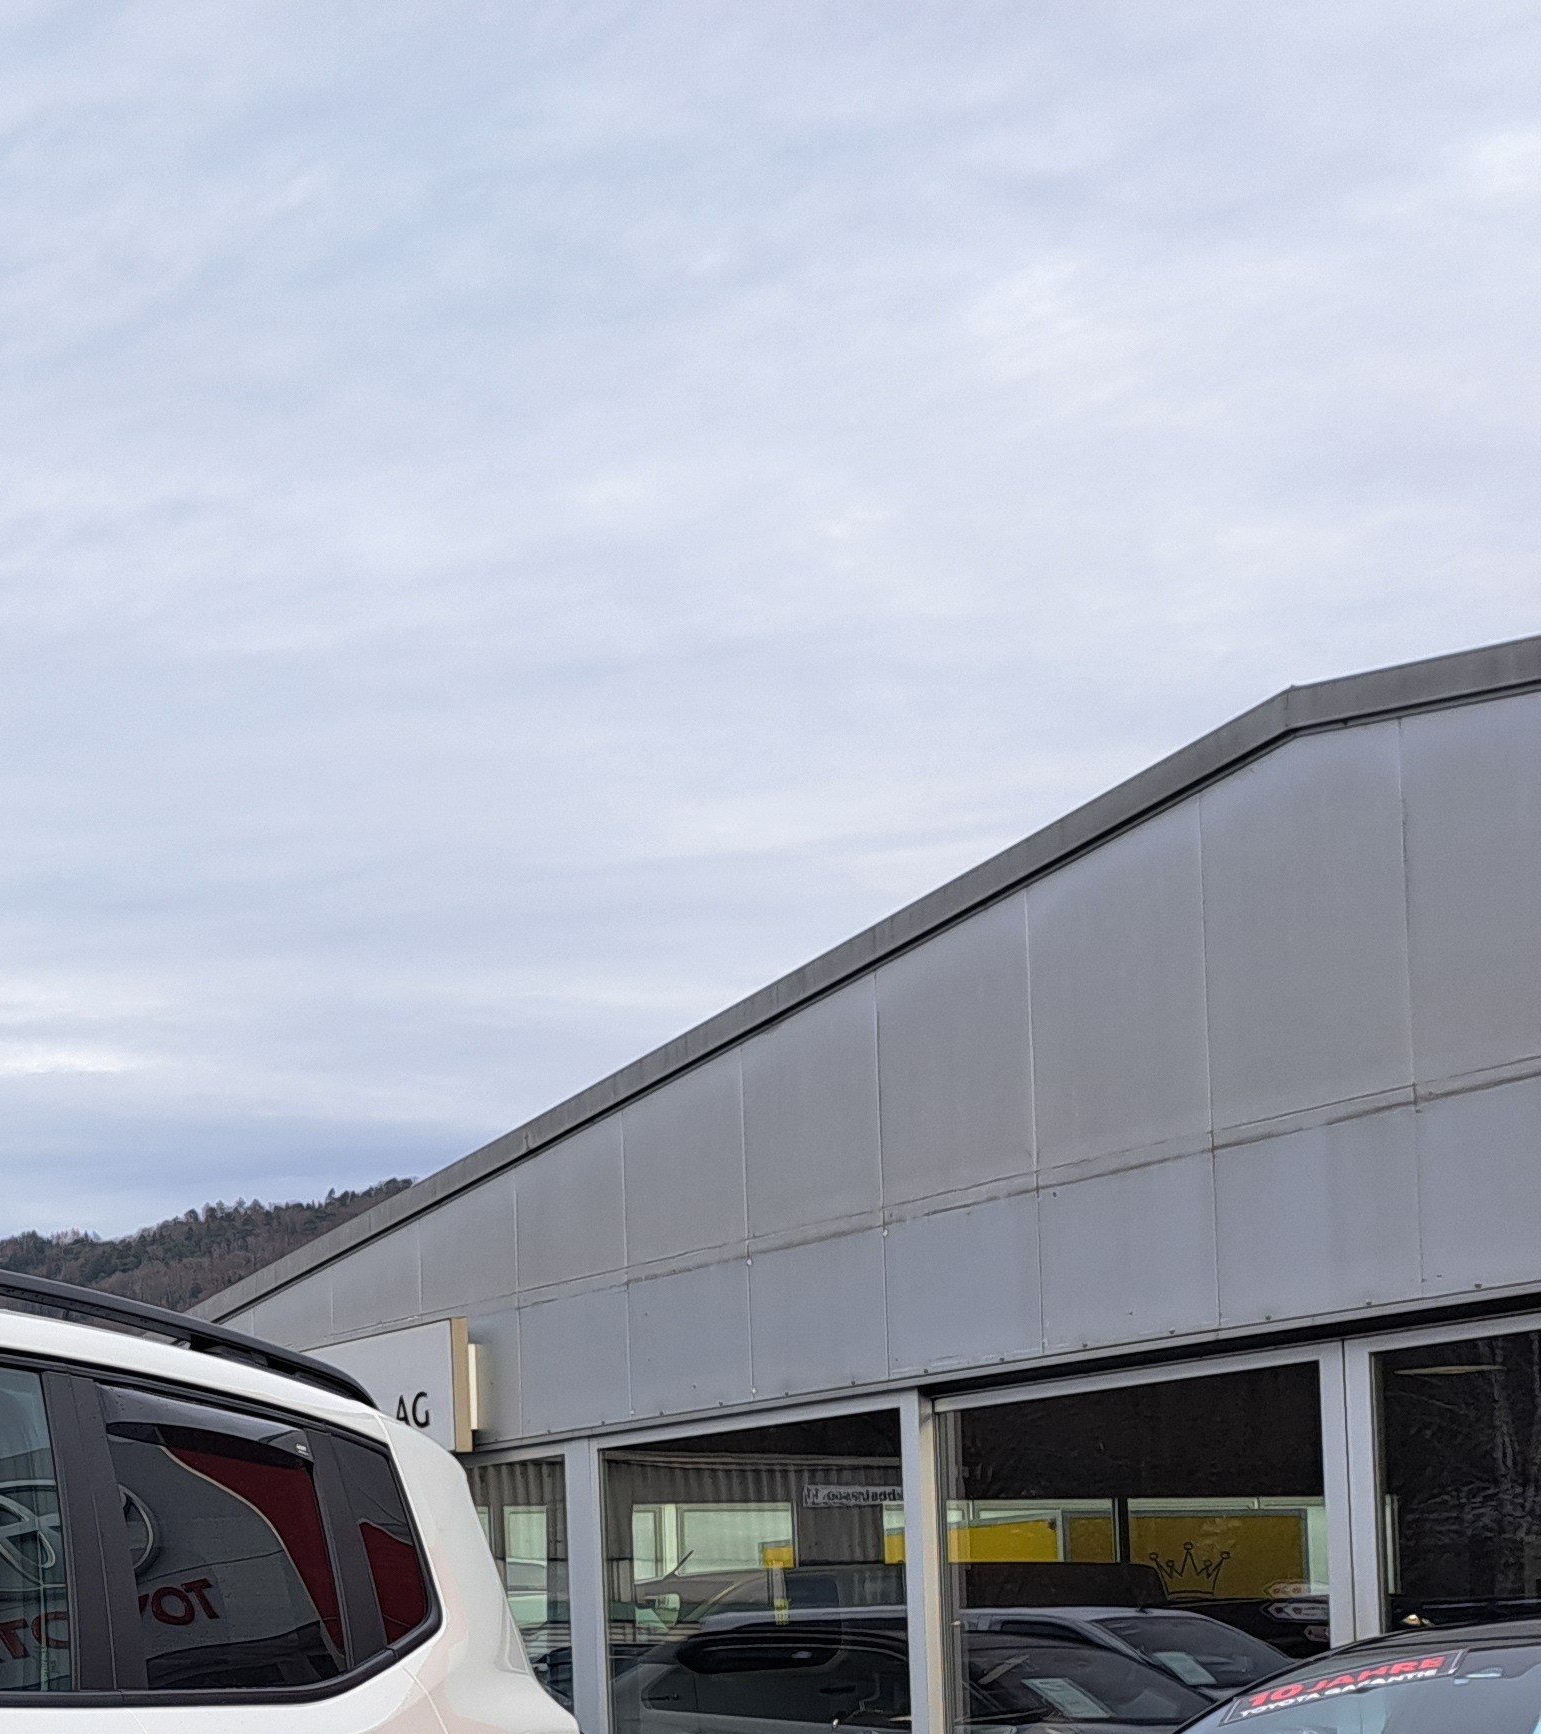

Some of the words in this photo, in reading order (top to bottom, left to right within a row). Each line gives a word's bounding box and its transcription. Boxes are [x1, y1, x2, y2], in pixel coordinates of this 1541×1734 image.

[396, 1391, 430, 1428] AG
[1239, 1692, 1321, 1718] TOYOTA
[1324, 1669, 1438, 1697] GARANTIE
[1248, 1683, 1305, 1708] 10
[1305, 1656, 1446, 1693] JAHRE
